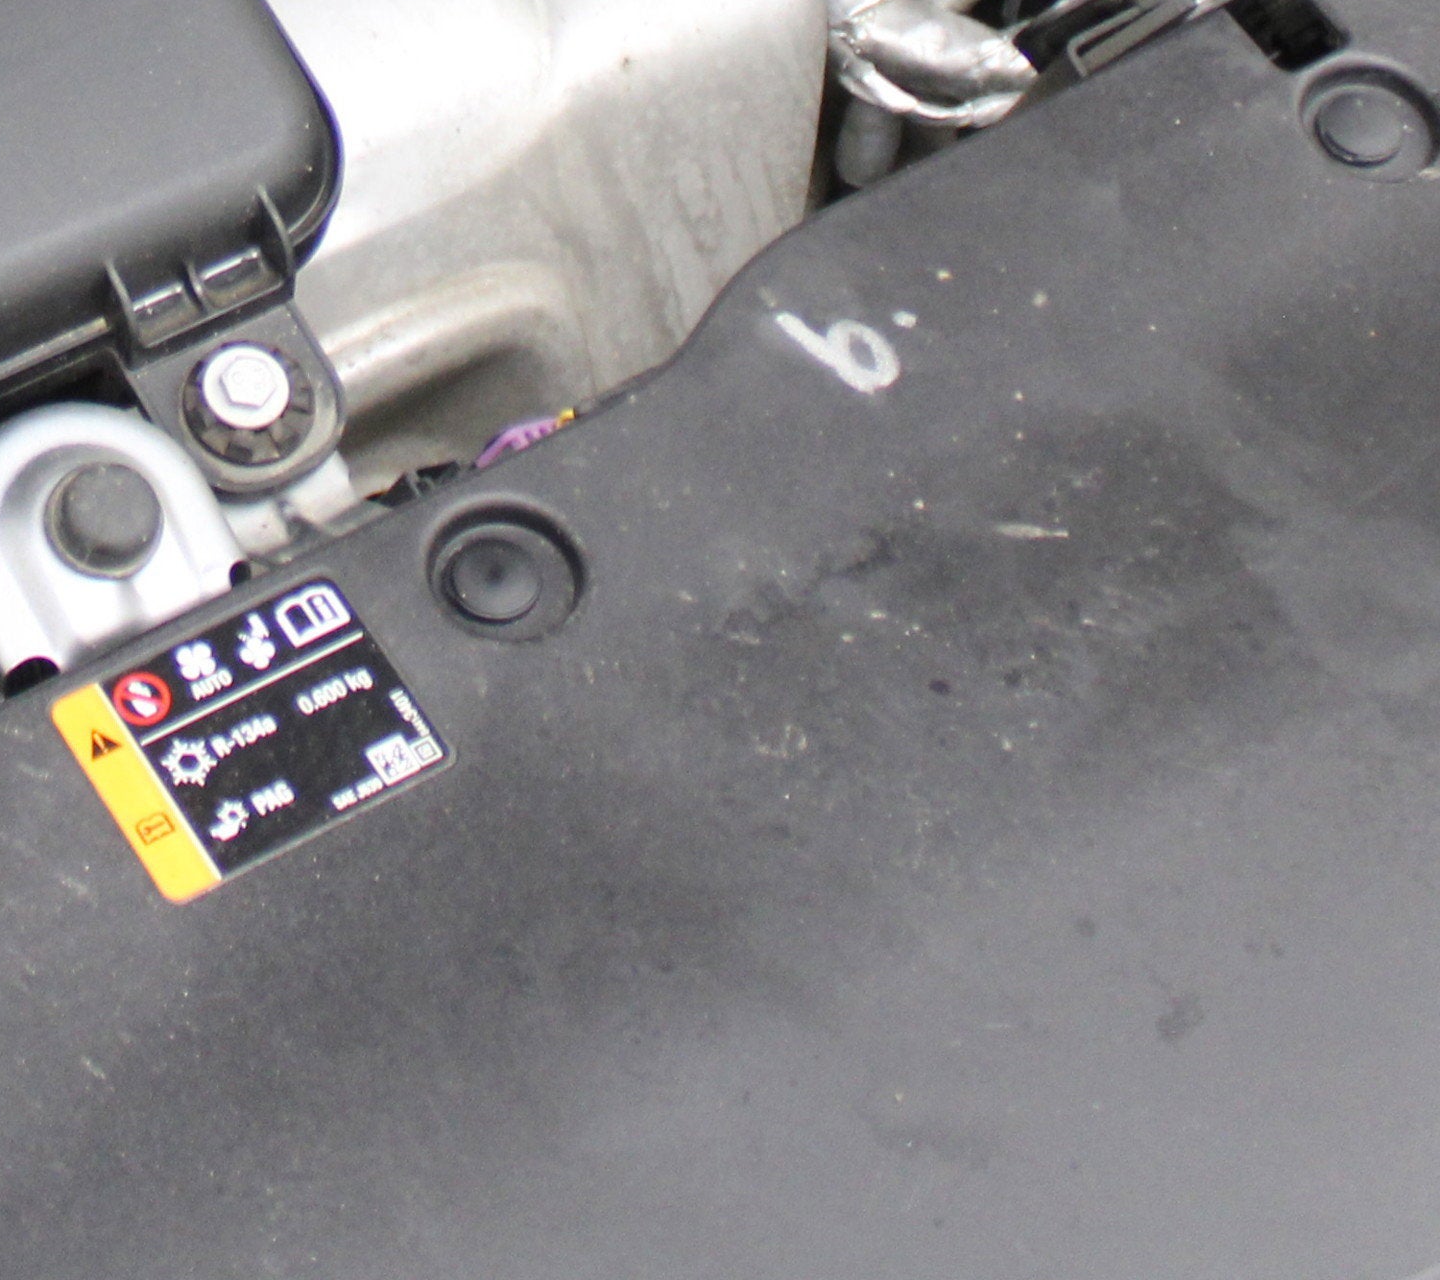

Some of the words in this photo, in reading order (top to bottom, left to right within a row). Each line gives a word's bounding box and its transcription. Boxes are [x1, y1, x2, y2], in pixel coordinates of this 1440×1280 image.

[191, 668, 234, 702] AUTO
[210, 714, 279, 759] R-134a
[295, 678, 348, 716] 0.600
[346, 666, 375, 697] kg
[250, 779, 297, 817] PAG
